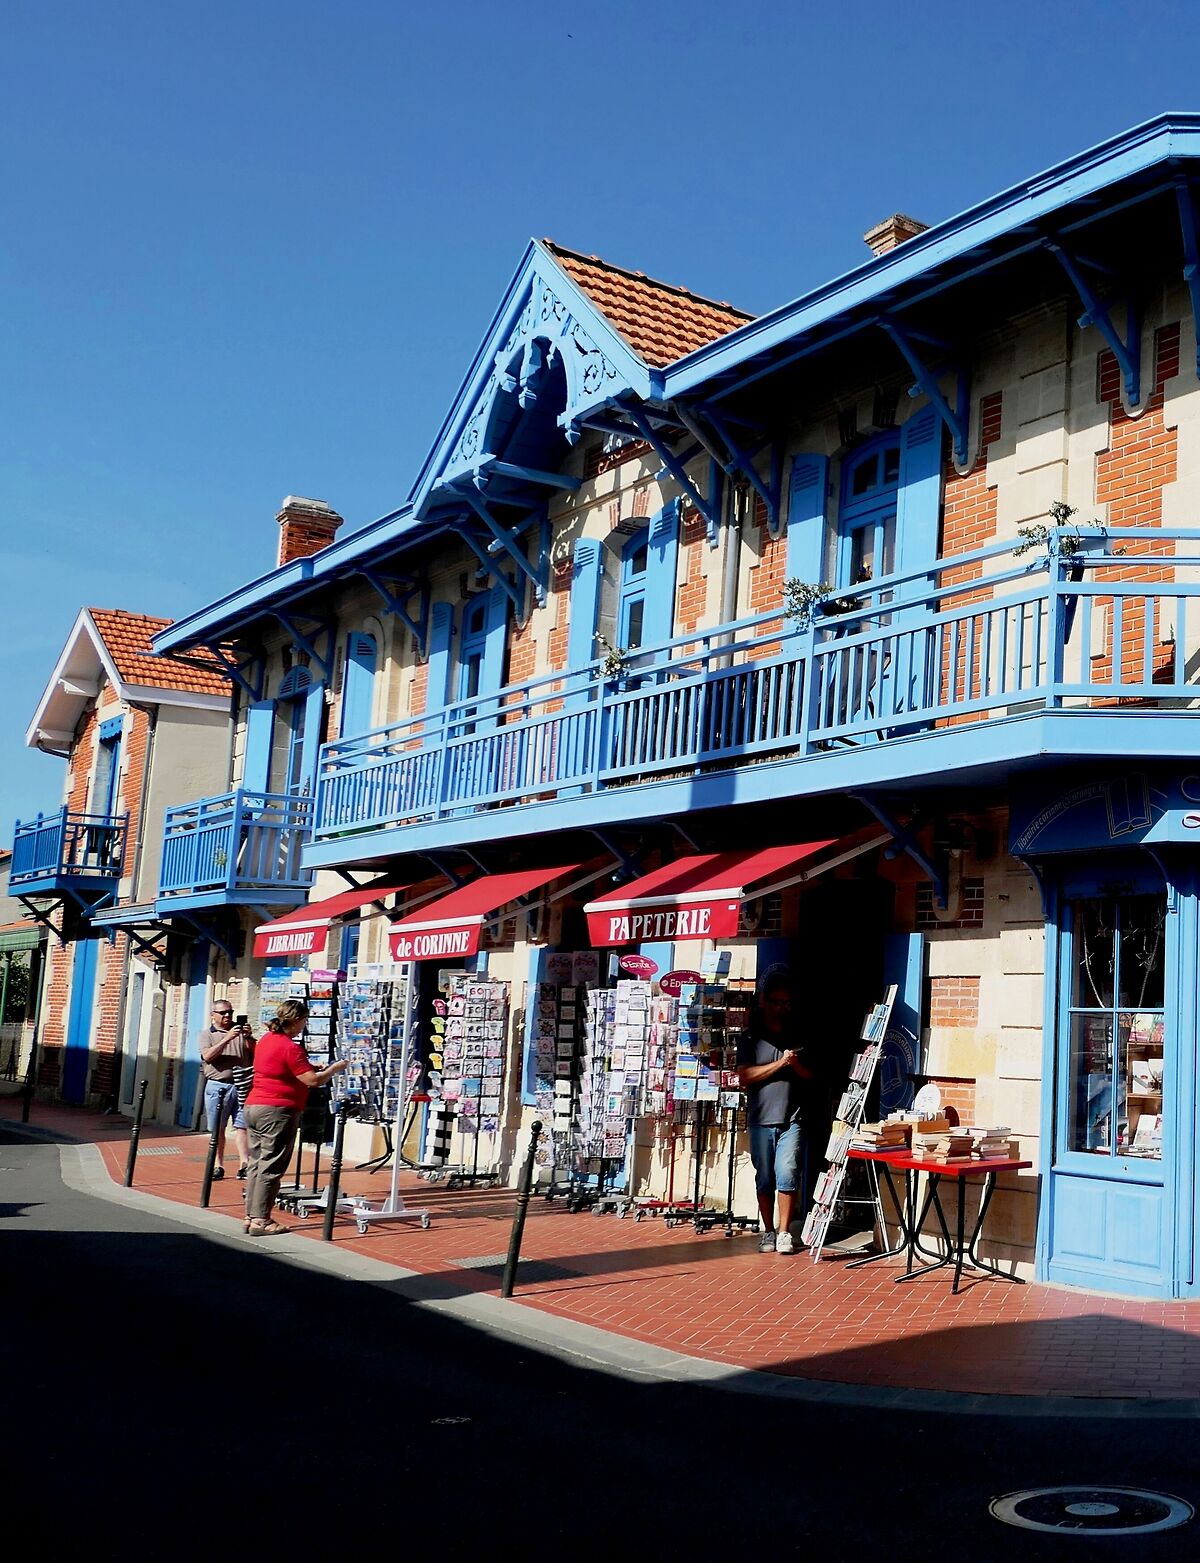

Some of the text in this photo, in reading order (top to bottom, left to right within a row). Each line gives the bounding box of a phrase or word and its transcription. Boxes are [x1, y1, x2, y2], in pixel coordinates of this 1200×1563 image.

[608, 908, 711, 941] PAPETERIE
[265, 932, 315, 953] LIBRAIRIE
[396, 931, 470, 958] de CORINNE
